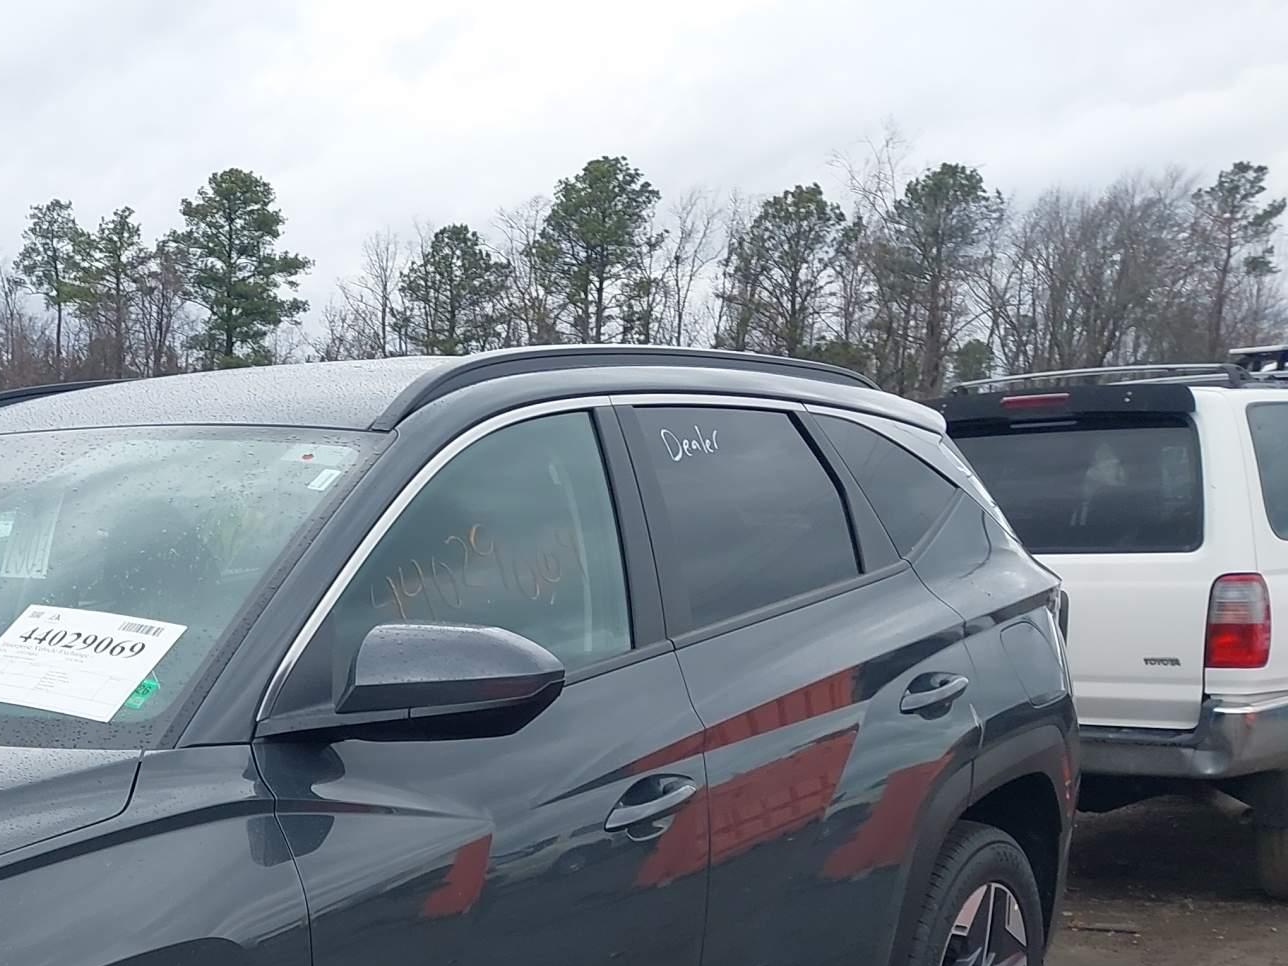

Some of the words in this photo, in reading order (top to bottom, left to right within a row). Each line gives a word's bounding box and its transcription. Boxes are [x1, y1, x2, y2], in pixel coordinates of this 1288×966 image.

[660, 424, 718, 461] Dealer
[19, 626, 146, 659] 44029069
[1143, 657, 1181, 666] TOYOTA
